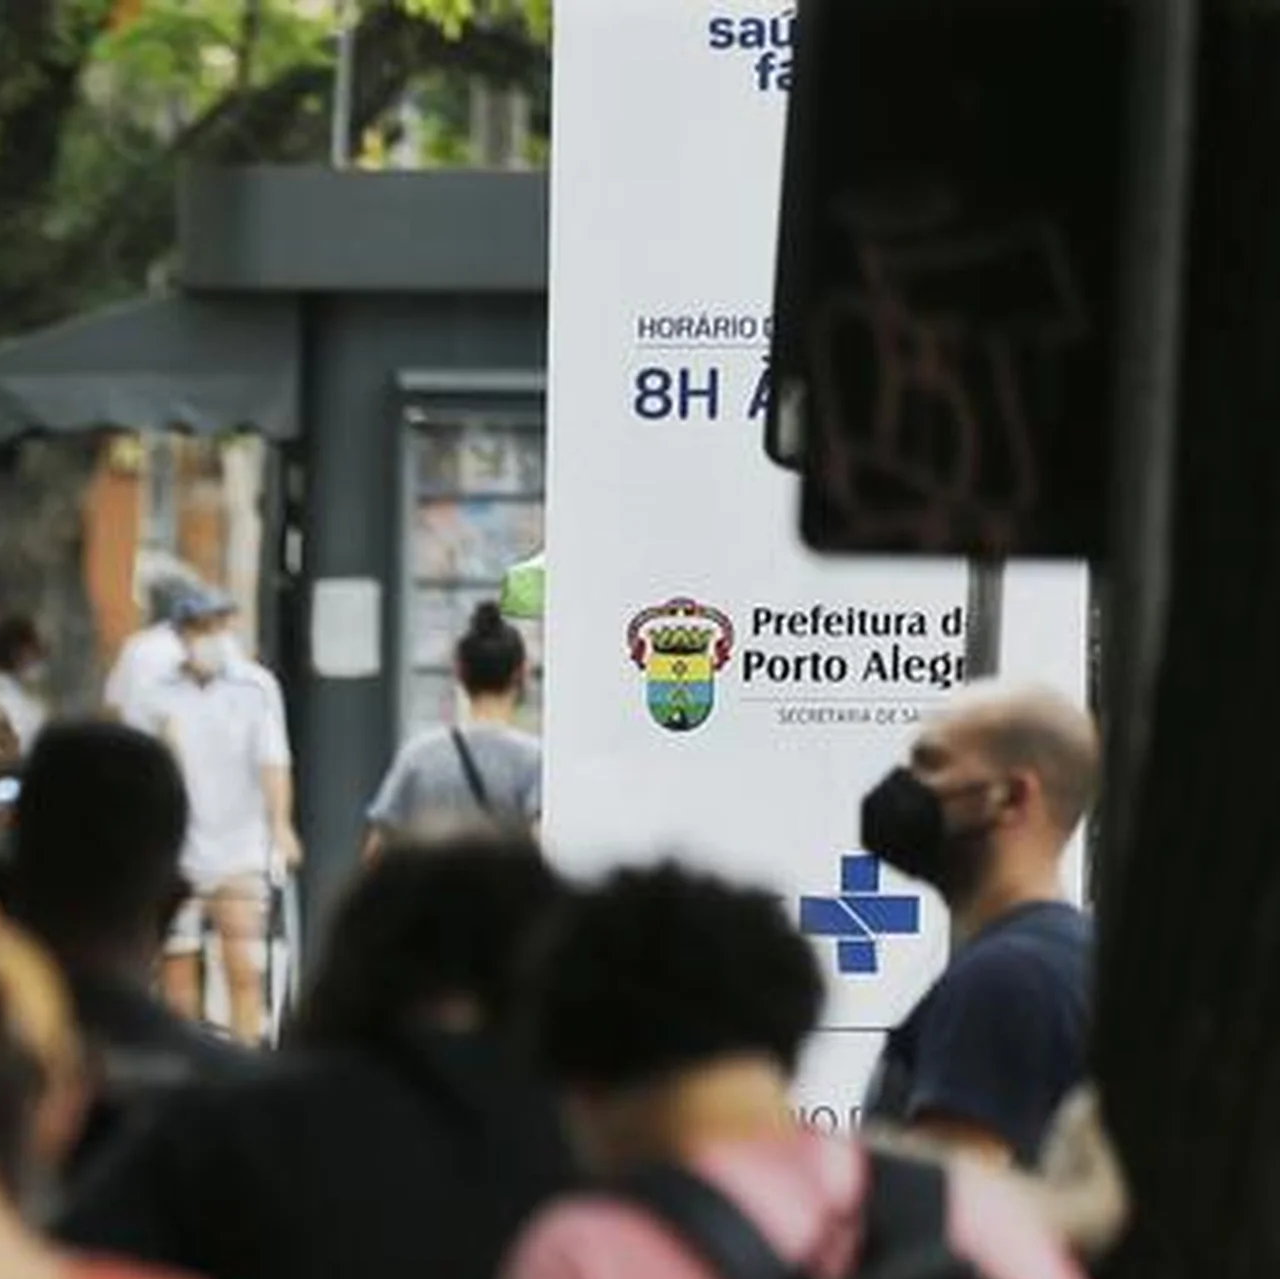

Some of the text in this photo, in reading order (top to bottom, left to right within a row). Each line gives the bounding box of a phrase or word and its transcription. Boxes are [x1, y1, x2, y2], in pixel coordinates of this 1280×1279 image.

[638, 311, 757, 339] HORÁRIO
[635, 367, 718, 420] 8H
[752, 605, 926, 637] Prefeitura
[742, 650, 848, 683] Porto
[777, 706, 871, 725] SECRETARIA
